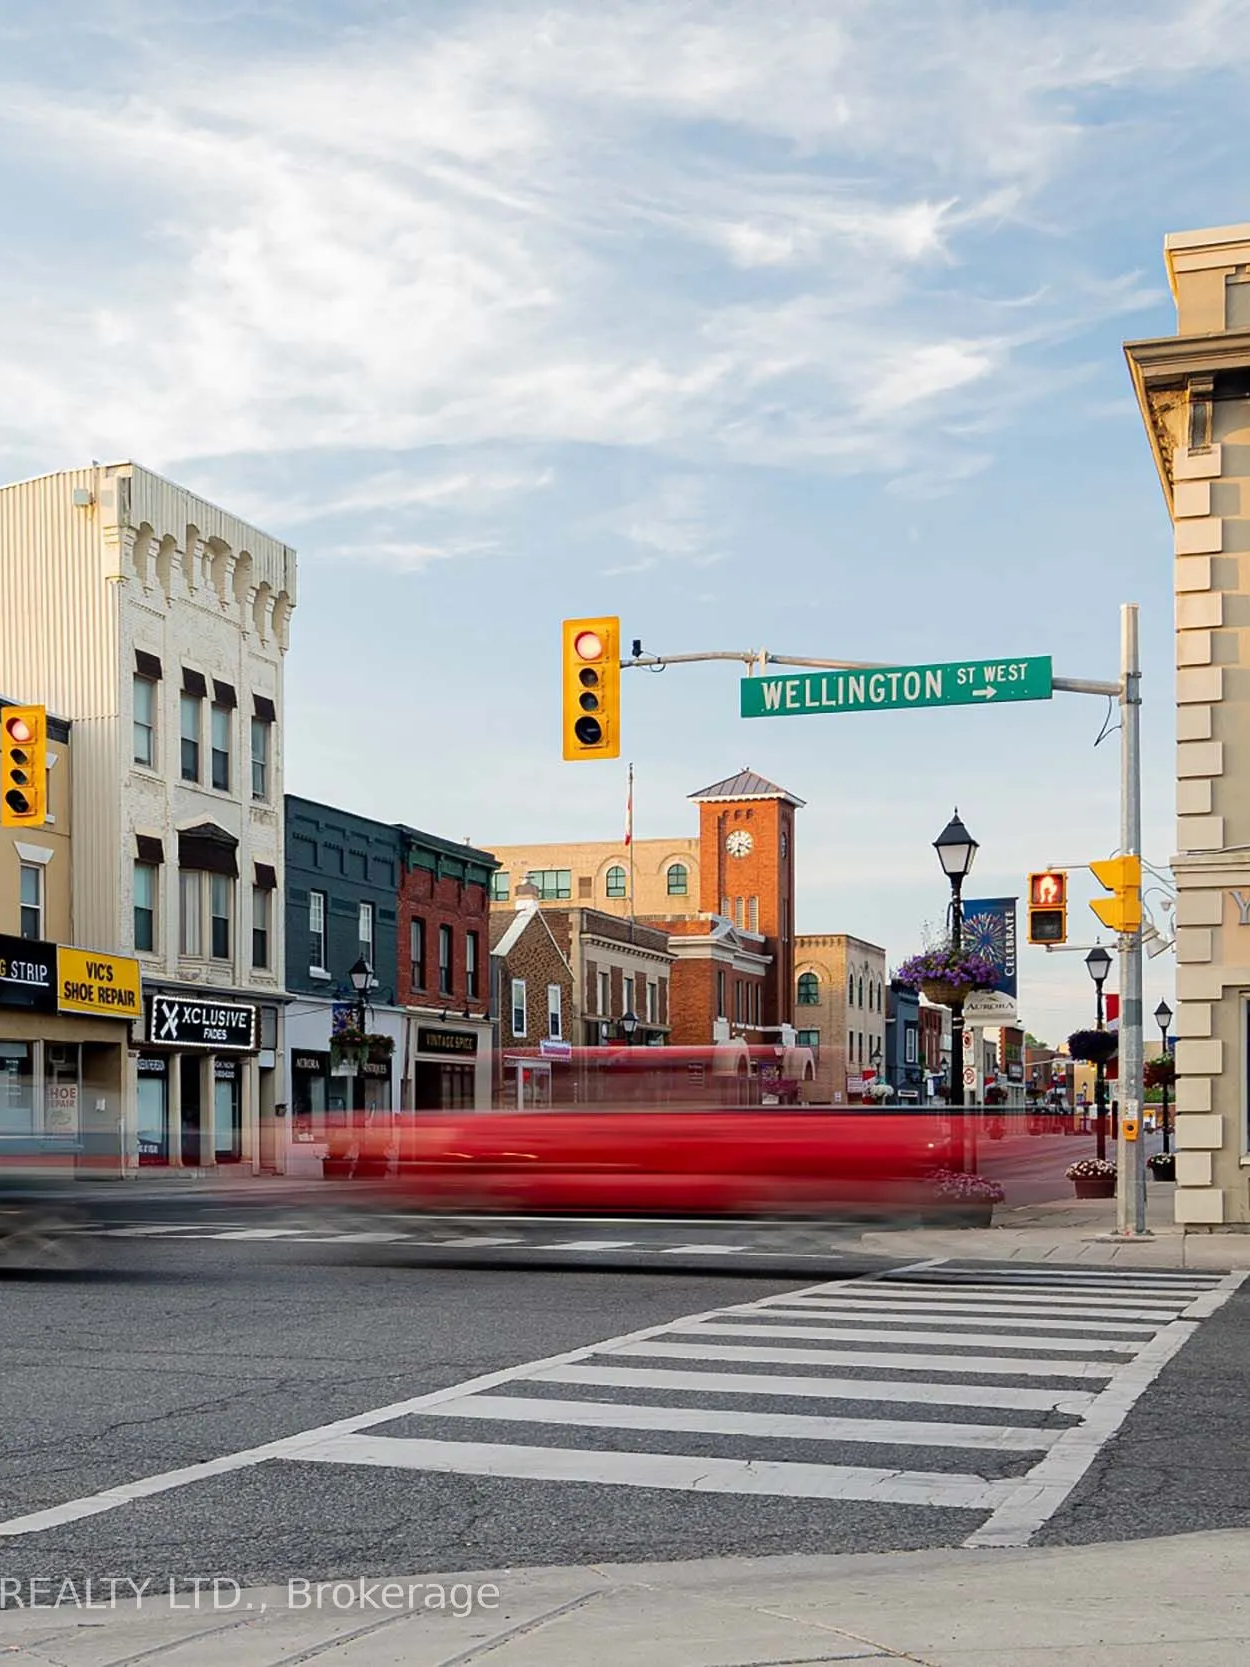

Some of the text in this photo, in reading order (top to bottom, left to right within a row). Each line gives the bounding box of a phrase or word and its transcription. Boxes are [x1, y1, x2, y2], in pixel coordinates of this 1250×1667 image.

[760, 663, 1029, 711] WELLINGTON ST WEST
[1004, 911, 1015, 976] CELEBRATE
[11, 962, 48, 982] STRIP
[86, 961, 113, 982] VIC'S
[64, 981, 135, 1008] SHOE REPAIR
[966, 1002, 1014, 1010] AURORA
[182, 1006, 248, 1028] XCLUSIVE
[203, 1027, 227, 1041] FADES
[50, 1087, 76, 1099] HOE
